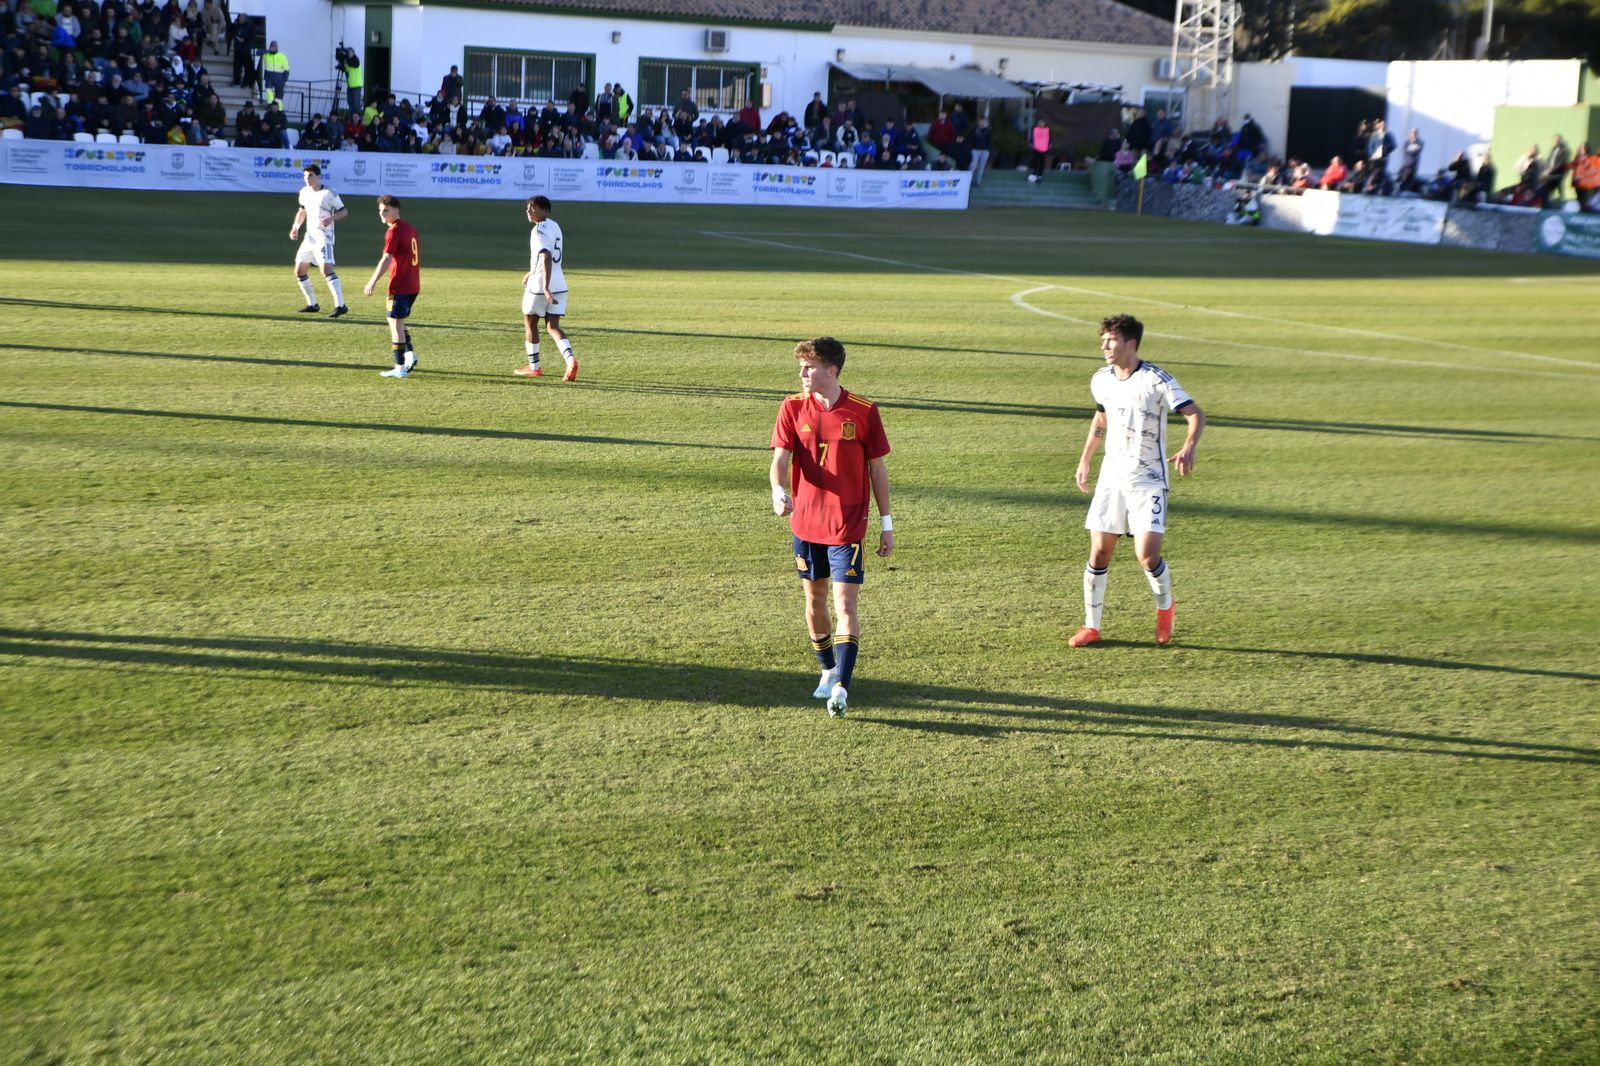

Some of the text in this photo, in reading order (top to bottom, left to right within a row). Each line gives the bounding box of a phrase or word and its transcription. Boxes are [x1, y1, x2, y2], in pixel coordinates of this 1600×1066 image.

[64, 163, 146, 173] TORREMOLINOS
[254, 170, 330, 180] TORREMOS
[431, 176, 502, 185] TORREMOLINOS
[596, 180, 663, 189] TORREMOLINOS
[752, 185, 816, 195] TORREMOLINOS
[412, 237, 418, 266] 9
[552, 237, 562, 264] 5
[818, 443, 829, 466] 7
[1150, 495, 1162, 515] 3
[851, 543, 860, 566] 7
